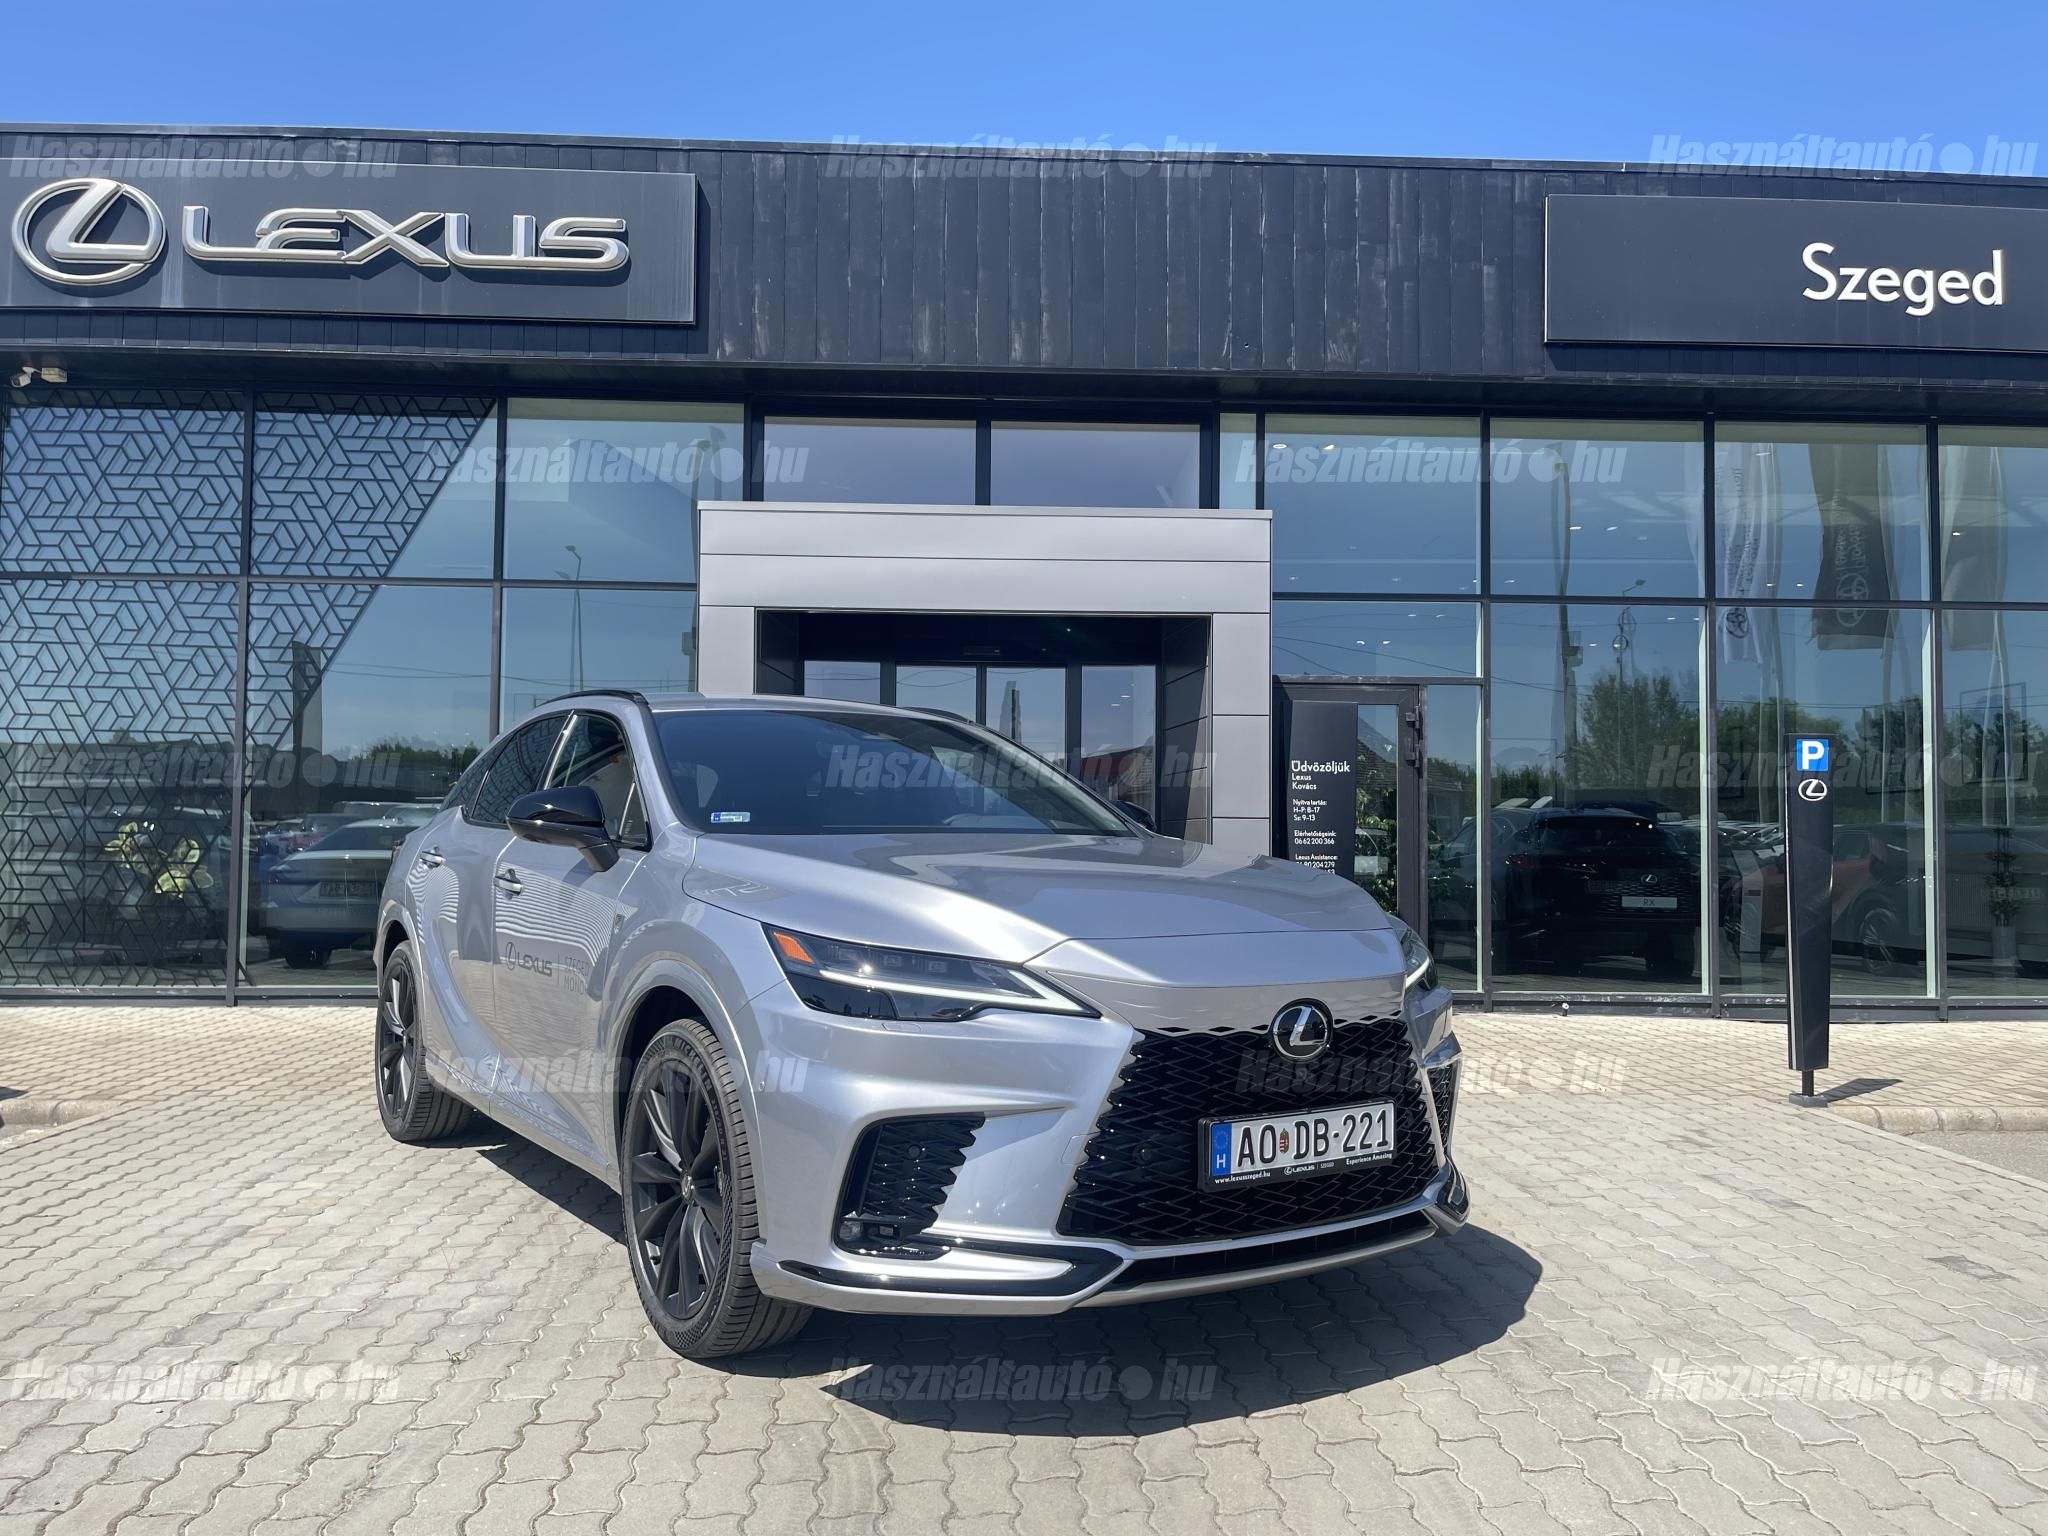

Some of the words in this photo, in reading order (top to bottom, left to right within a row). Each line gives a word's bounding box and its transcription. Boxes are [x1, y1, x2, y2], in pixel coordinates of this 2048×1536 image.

[183, 205, 629, 272] LEXUS
[1802, 242, 2003, 317] Szeged
[1802, 740, 1825, 770] P
[1291, 760, 1350, 775] Üdvözöljük
[1291, 772, 1312, 781] Lexus
[1292, 781, 1317, 790] Kovács
[1311, 837, 1323, 845] 200
[1295, 853, 1310, 861] Lexus
[517, 951, 553, 977] LEXUS
[1216, 1153, 1227, 1170] H
[1346, 1155, 1372, 1166] Experience
[1372, 1152, 1392, 1161] Amazing
[1292, 1164, 1315, 1173] LEXUS
